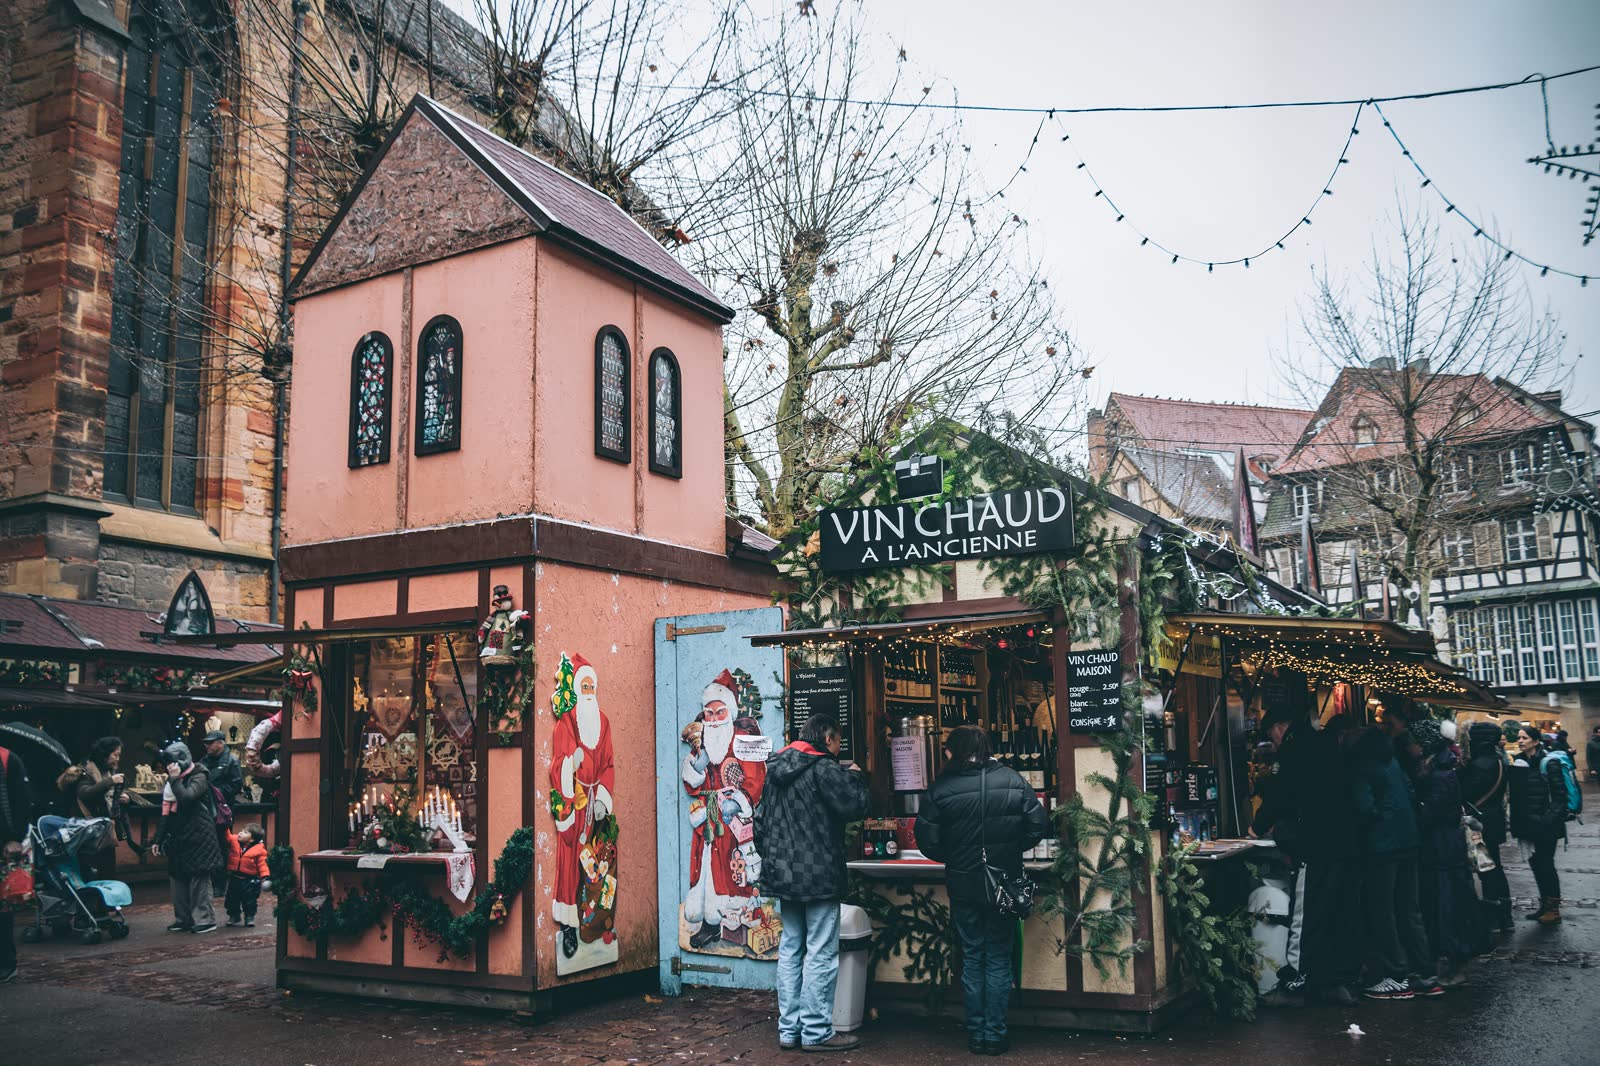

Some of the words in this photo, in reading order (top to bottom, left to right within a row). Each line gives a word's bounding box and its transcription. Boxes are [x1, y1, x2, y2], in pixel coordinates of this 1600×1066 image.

[830, 506, 905, 545] VIN
[914, 487, 1066, 537] CHAUD
[861, 547, 879, 563] A
[887, 530, 1037, 561] L'ANCIENNE
[1068, 655, 1085, 665] VIN
[1087, 652, 1118, 664] CHAUD
[1076, 665, 1112, 676] MAISON
[1069, 686, 1089, 694] rouge
[1185, 773, 1200, 801] perle
